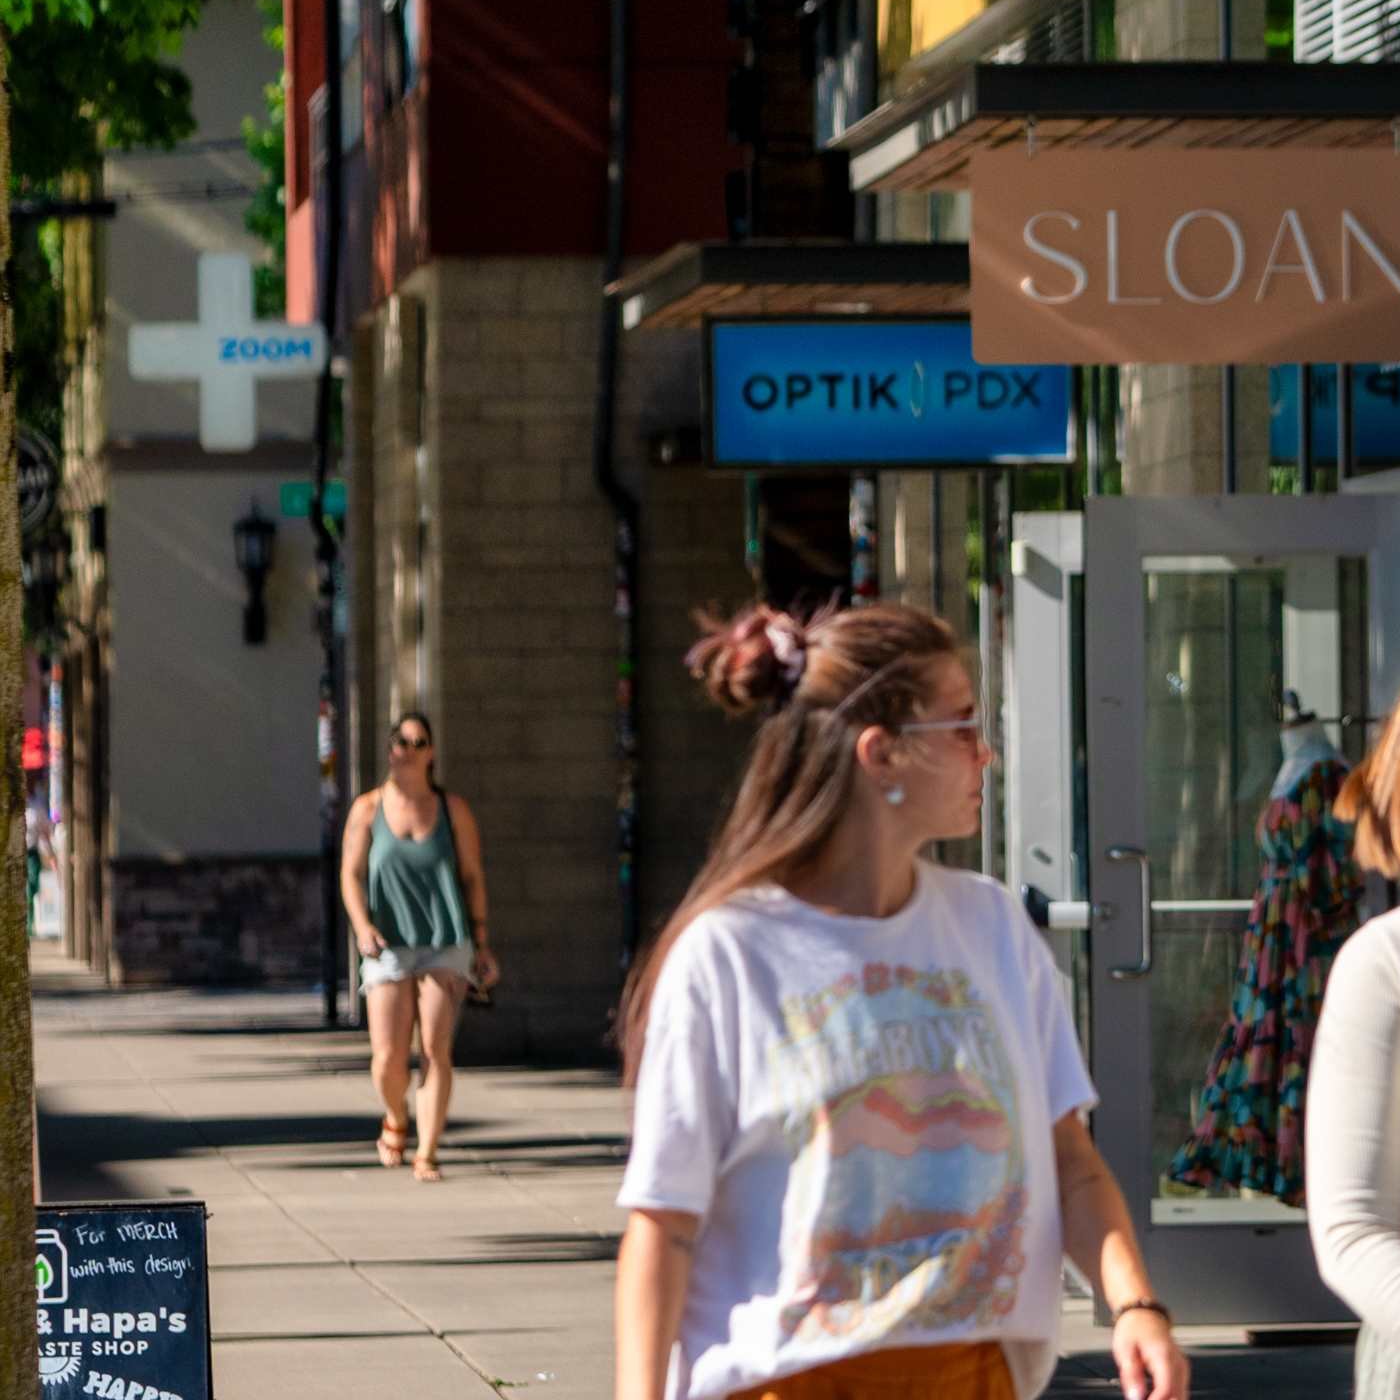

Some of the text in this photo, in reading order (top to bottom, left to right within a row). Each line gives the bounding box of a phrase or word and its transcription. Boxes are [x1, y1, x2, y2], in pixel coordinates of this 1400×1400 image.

[219, 338, 312, 361] ZOOM
[742, 371, 1041, 411] OPTIK PDX
[74, 1221, 178, 1246] For MERCH
[70, 1259, 104, 1279] with
[107, 1257, 136, 1277] this
[36, 1307, 187, 1339] & Hapa's
[38, 1340, 149, 1357] STE SHOP
